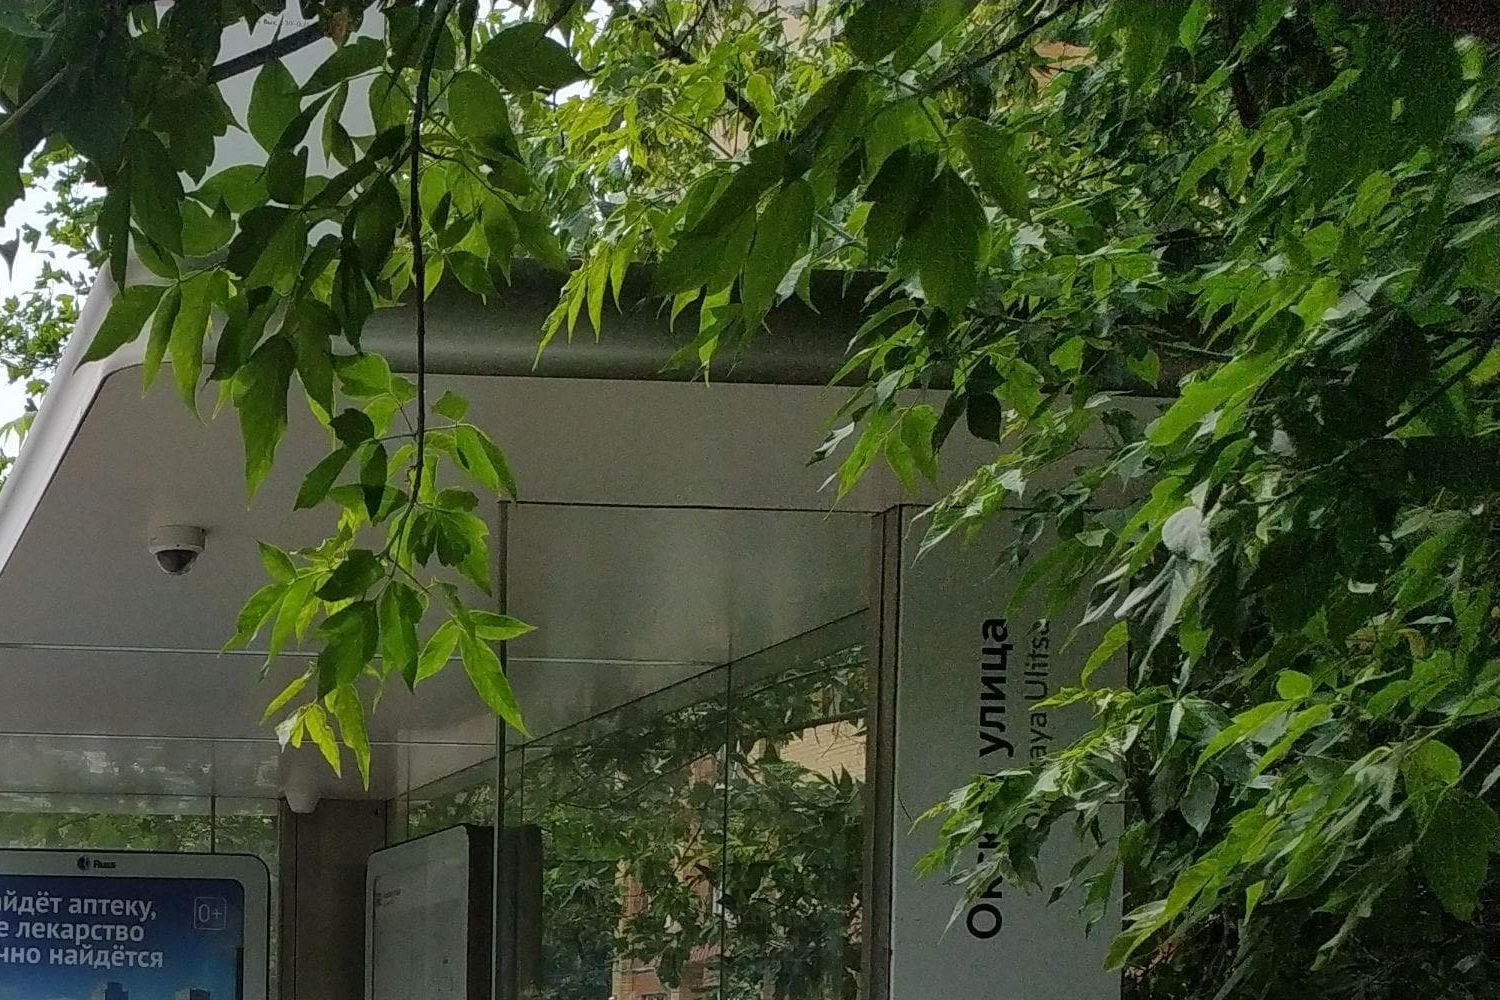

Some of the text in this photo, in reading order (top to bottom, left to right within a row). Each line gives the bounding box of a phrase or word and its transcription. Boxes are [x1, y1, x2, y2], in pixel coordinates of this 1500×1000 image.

[978, 617, 1014, 758] улица
[68, 897, 157, 922] аптеку,
[198, 903, 223, 923] 0+
[15, 921, 145, 945] лекарство
[50, 942, 164, 970] найдётся
